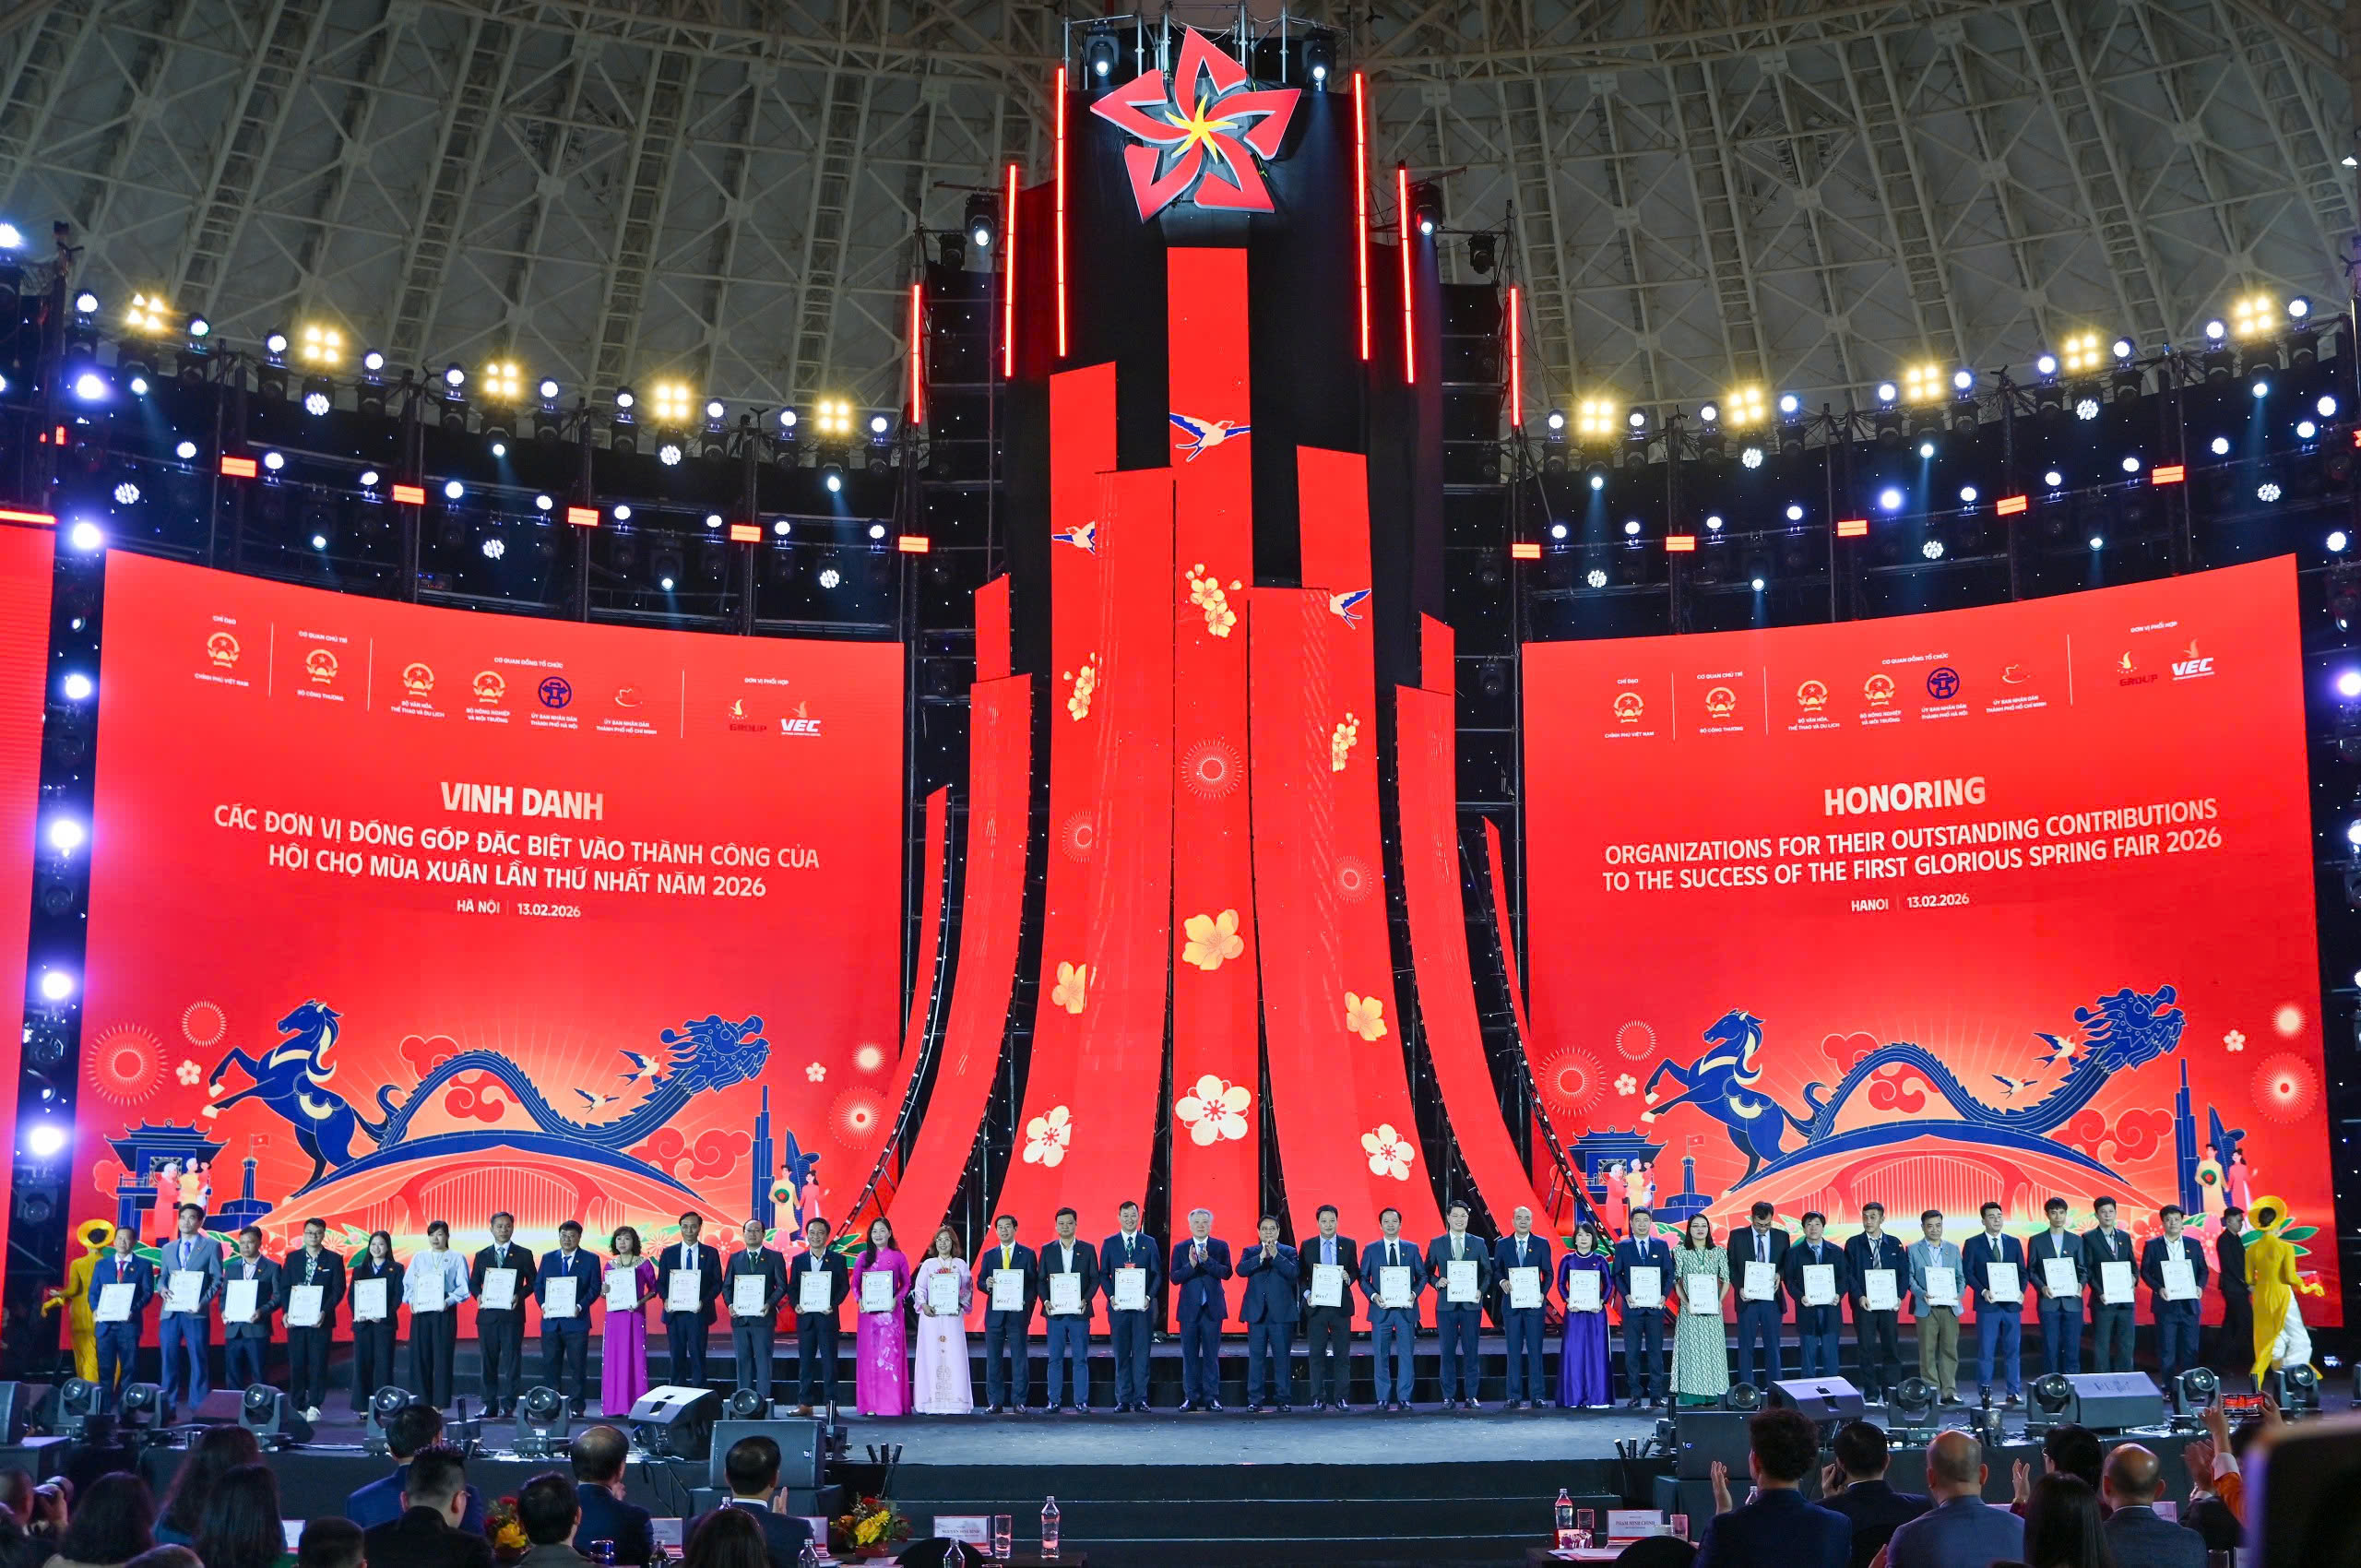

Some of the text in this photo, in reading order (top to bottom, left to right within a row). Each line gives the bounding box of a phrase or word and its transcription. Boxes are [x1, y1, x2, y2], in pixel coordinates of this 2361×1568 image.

[2171, 657, 2214, 676] VEC
[780, 719, 822, 732] VEC
[441, 782, 603, 820] VINH DANH
[1824, 777, 1985, 815] HONORING
[215, 803, 819, 868] CÁC ĐƠN VỊ ĐÓNG GÓP ĐẶC BIỆT VÀO THÀNH CÔNG CỦA
[1605, 798, 2217, 864] ORGANIZATIONS FOR THEIR OUTSTANDING CONTRIBUTIONS
[269, 842, 766, 897] HỘI CHỢ MÙA XUÂN LẦN THỨ NHẤT NĂM 2026
[1603, 826, 2221, 891] TO THE SUCCESS OF THE FIRST GLORIOUS SPRING FAIR 2026
[457, 898, 581, 917] HÀ NỘI 13.02.2026
[1851, 893, 1969, 912] HANOI 13.02.2026
